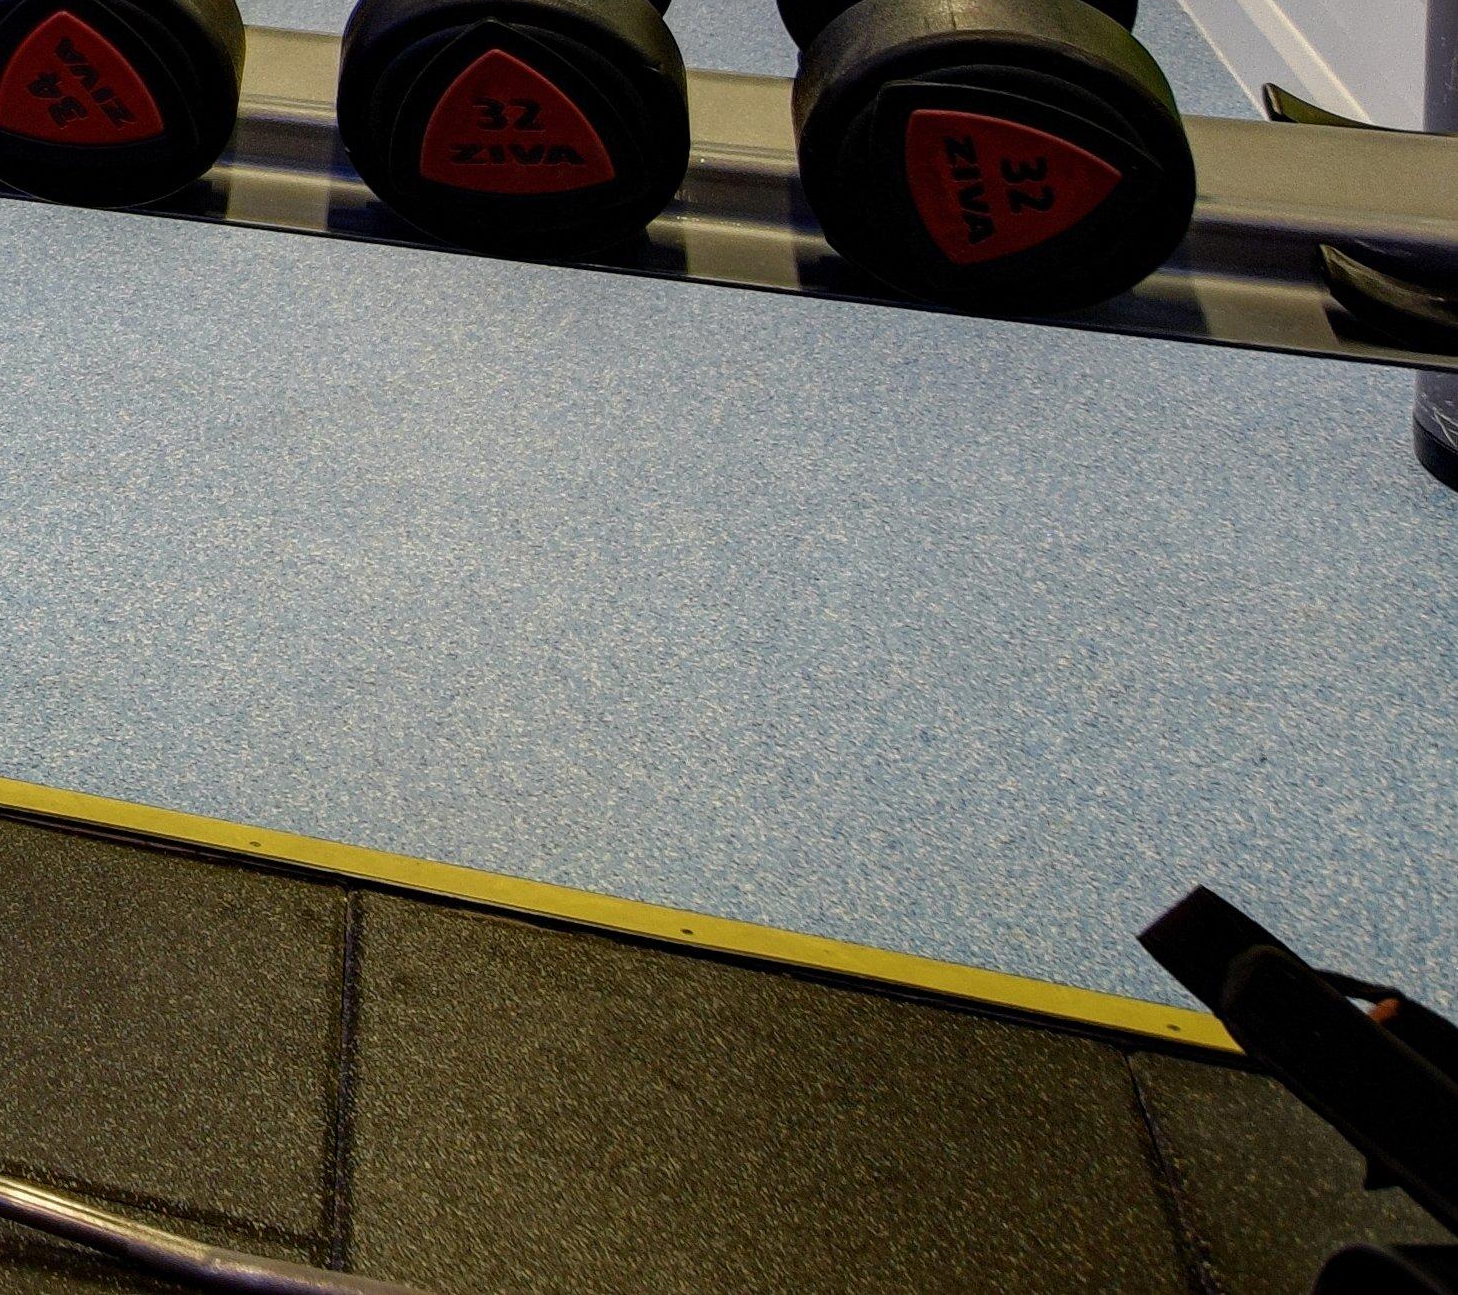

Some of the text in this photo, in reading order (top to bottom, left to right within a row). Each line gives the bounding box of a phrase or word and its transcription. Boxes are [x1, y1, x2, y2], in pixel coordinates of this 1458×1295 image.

[28, 71, 90, 131] 34
[54, 36, 138, 130] ZIVA
[471, 96, 548, 133] 32
[449, 143, 588, 167] ZIVA
[998, 154, 1053, 214] 32
[941, 131, 999, 247] ZIVA
